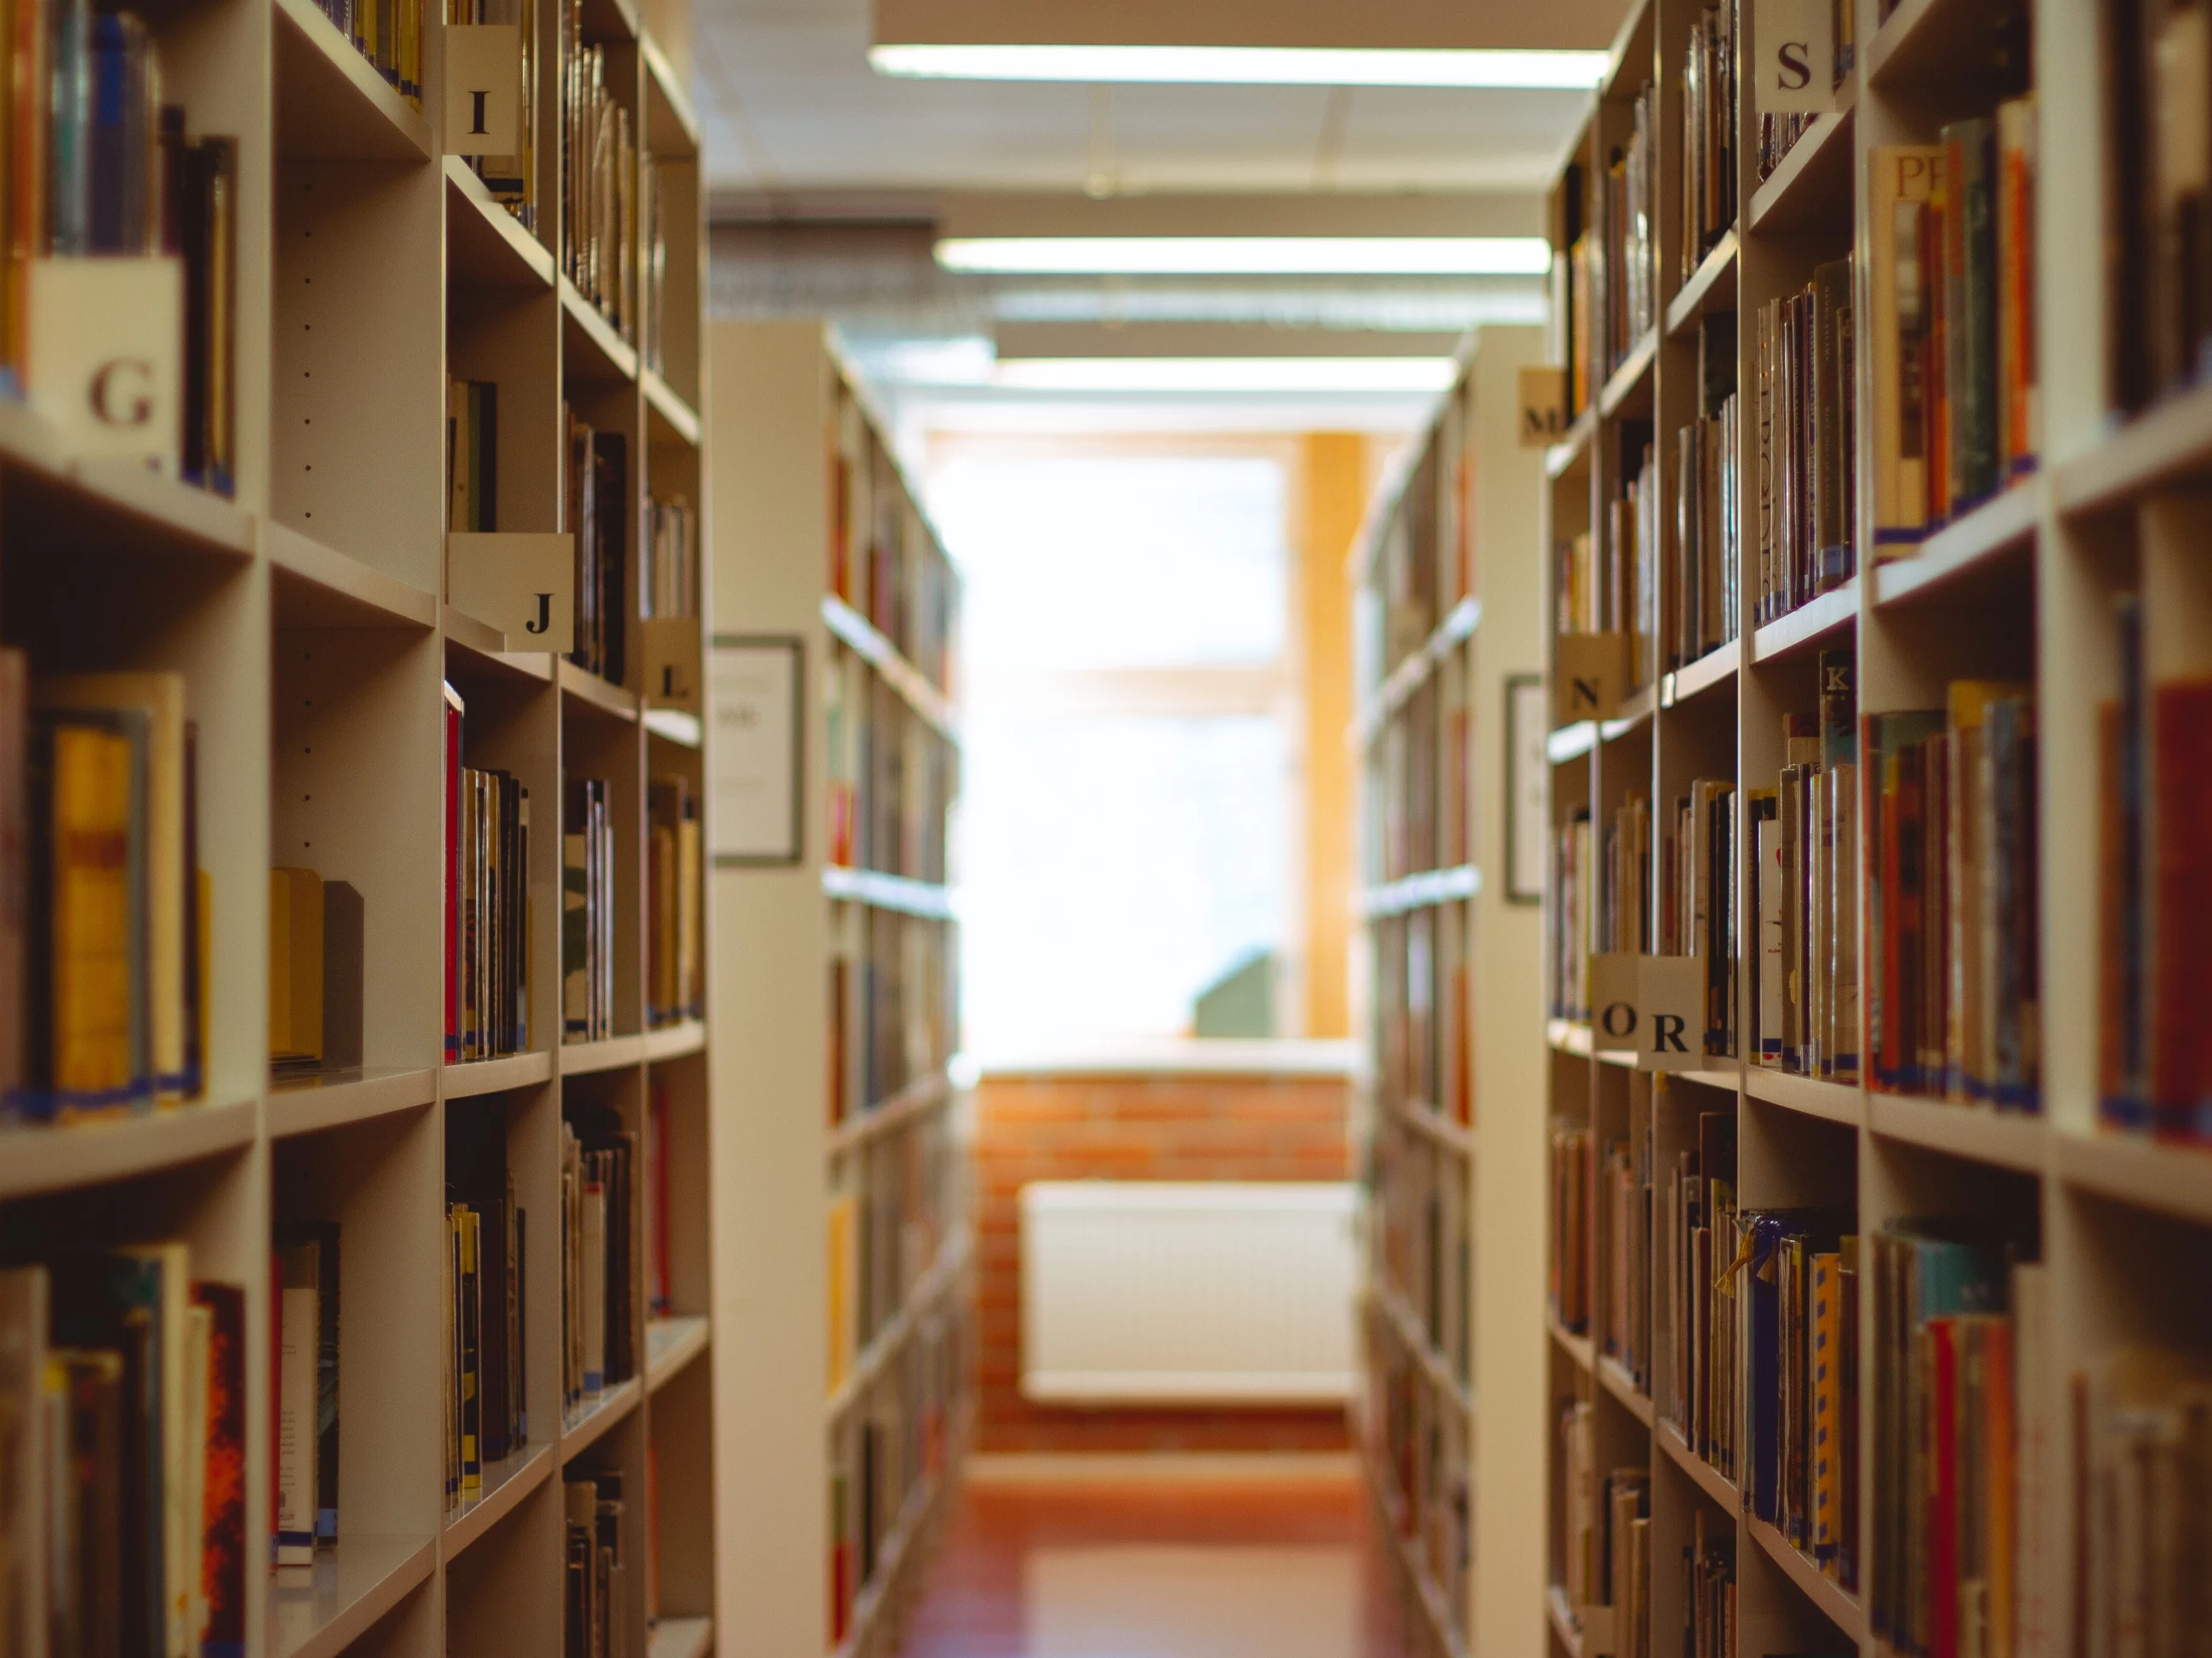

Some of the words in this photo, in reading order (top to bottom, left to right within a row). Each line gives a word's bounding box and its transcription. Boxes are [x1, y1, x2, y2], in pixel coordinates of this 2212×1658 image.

[1777, 42, 1811, 90] S
[467, 90, 491, 134] I
[88, 356, 154, 428] G
[1524, 407, 1560, 436] M
[525, 592, 556, 635] J
[661, 664, 689, 698] L
[1571, 676, 1601, 709] N
[1827, 666, 1850, 691] K
[1602, 1002, 1638, 1038] O
[1650, 1014, 1690, 1053] R
